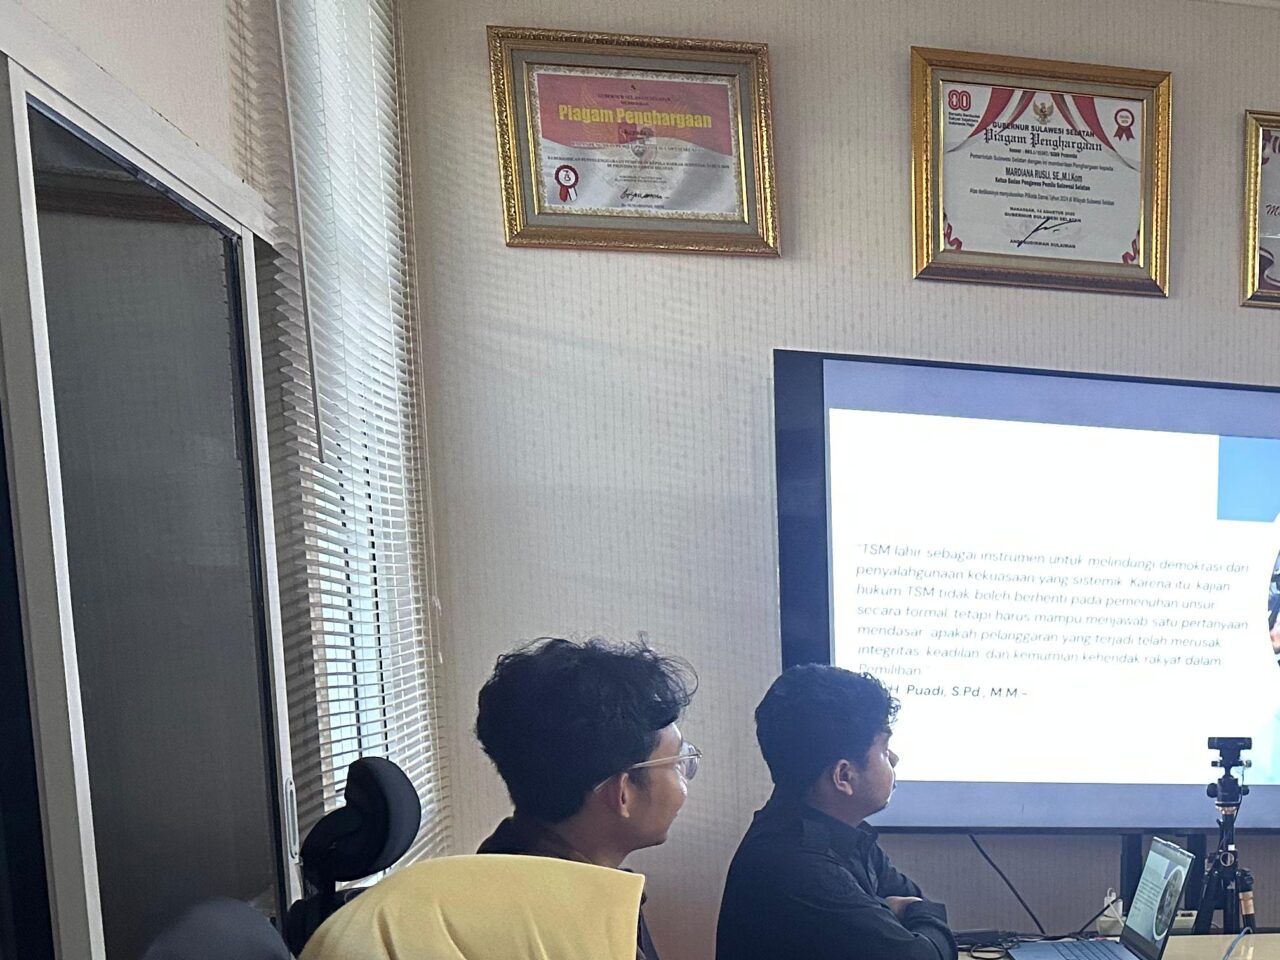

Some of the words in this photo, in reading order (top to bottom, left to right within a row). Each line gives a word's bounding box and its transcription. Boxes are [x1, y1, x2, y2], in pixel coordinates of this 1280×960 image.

[559, 104, 613, 124] Piagam
[616, 108, 712, 130] Penghargaan
[984, 128, 1027, 147] Piagam
[1030, 133, 1102, 152] Penghargaan
[993, 122, 1029, 132] GUBERNUR
[1031, 125, 1064, 135] SULAWESI
[1066, 128, 1094, 138] SELATAN
[1005, 167, 1034, 178] MARDIANA
[927, 547, 976, 562] sebagai
[981, 551, 1045, 564] instrumen
[1049, 554, 1082, 565] untuk
[1088, 557, 1155, 572] melindungi
[1160, 560, 1222, 572] demokrasi
[856, 564, 964, 581] penyalahgunaan
[968, 569, 1035, 583] kekuasaan
[1039, 574, 1069, 588] yang
[1130, 577, 1171, 589] Karena
[856, 584, 902, 597] hukum
[907, 585, 935, 598] TSM
[939, 587, 970, 600] tidak
[975, 588, 1010, 601] boleh
[1014, 590, 1067, 604] berhenti
[1070, 594, 1102, 607] pada
[1106, 596, 1178, 609] pemenuhan
[1182, 600, 1216, 610] unsur
[857, 606, 901, 617] secara
[954, 609, 991, 622] tetapi
[995, 610, 1030, 622] harus
[1034, 613, 1082, 626] mampu
[1086, 615, 1148, 628] menjawab
[1152, 618, 1178, 628] satu
[1181, 619, 1248, 631] pertanyaan
[931, 628, 977, 641] apakah
[981, 629, 1058, 644] pelanggaran
[1062, 634, 1092, 646] yang
[1095, 634, 1134, 647] terjadi
[1138, 635, 1167, 646] telah
[1171, 636, 1221, 649] merusak
[986, 648, 1010, 660] dan
[1083, 652, 1140, 664] kehendak
[1144, 654, 1182, 666] rakyat
[1186, 655, 1221, 667] dalam
[907, 684, 946, 698] Puadi,
